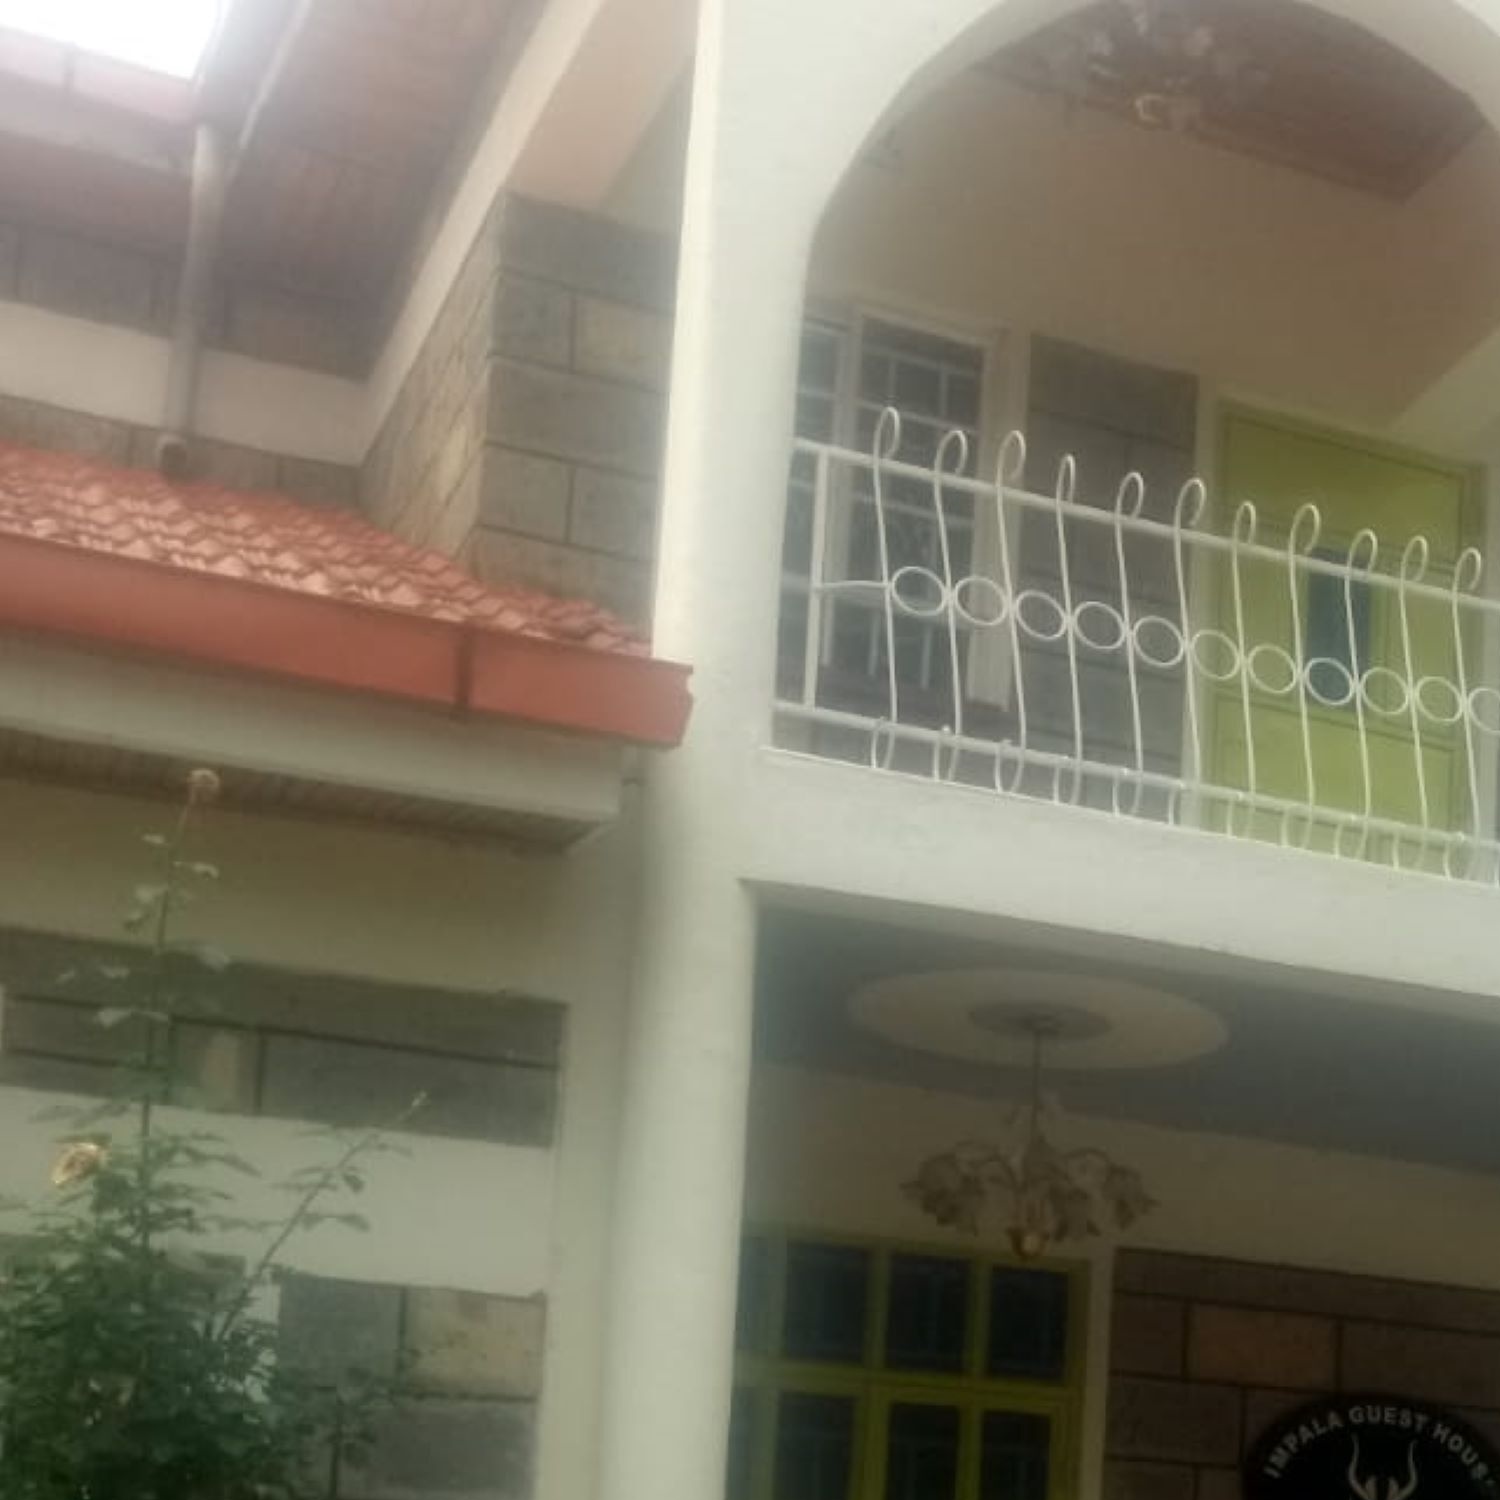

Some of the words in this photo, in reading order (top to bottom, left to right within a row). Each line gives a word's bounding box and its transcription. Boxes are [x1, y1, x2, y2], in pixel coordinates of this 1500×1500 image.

[1264, 1411, 1344, 1479] IMPALA
[1348, 1405, 1429, 1433] GUEST
[1432, 1422, 1496, 1487] HOUS
